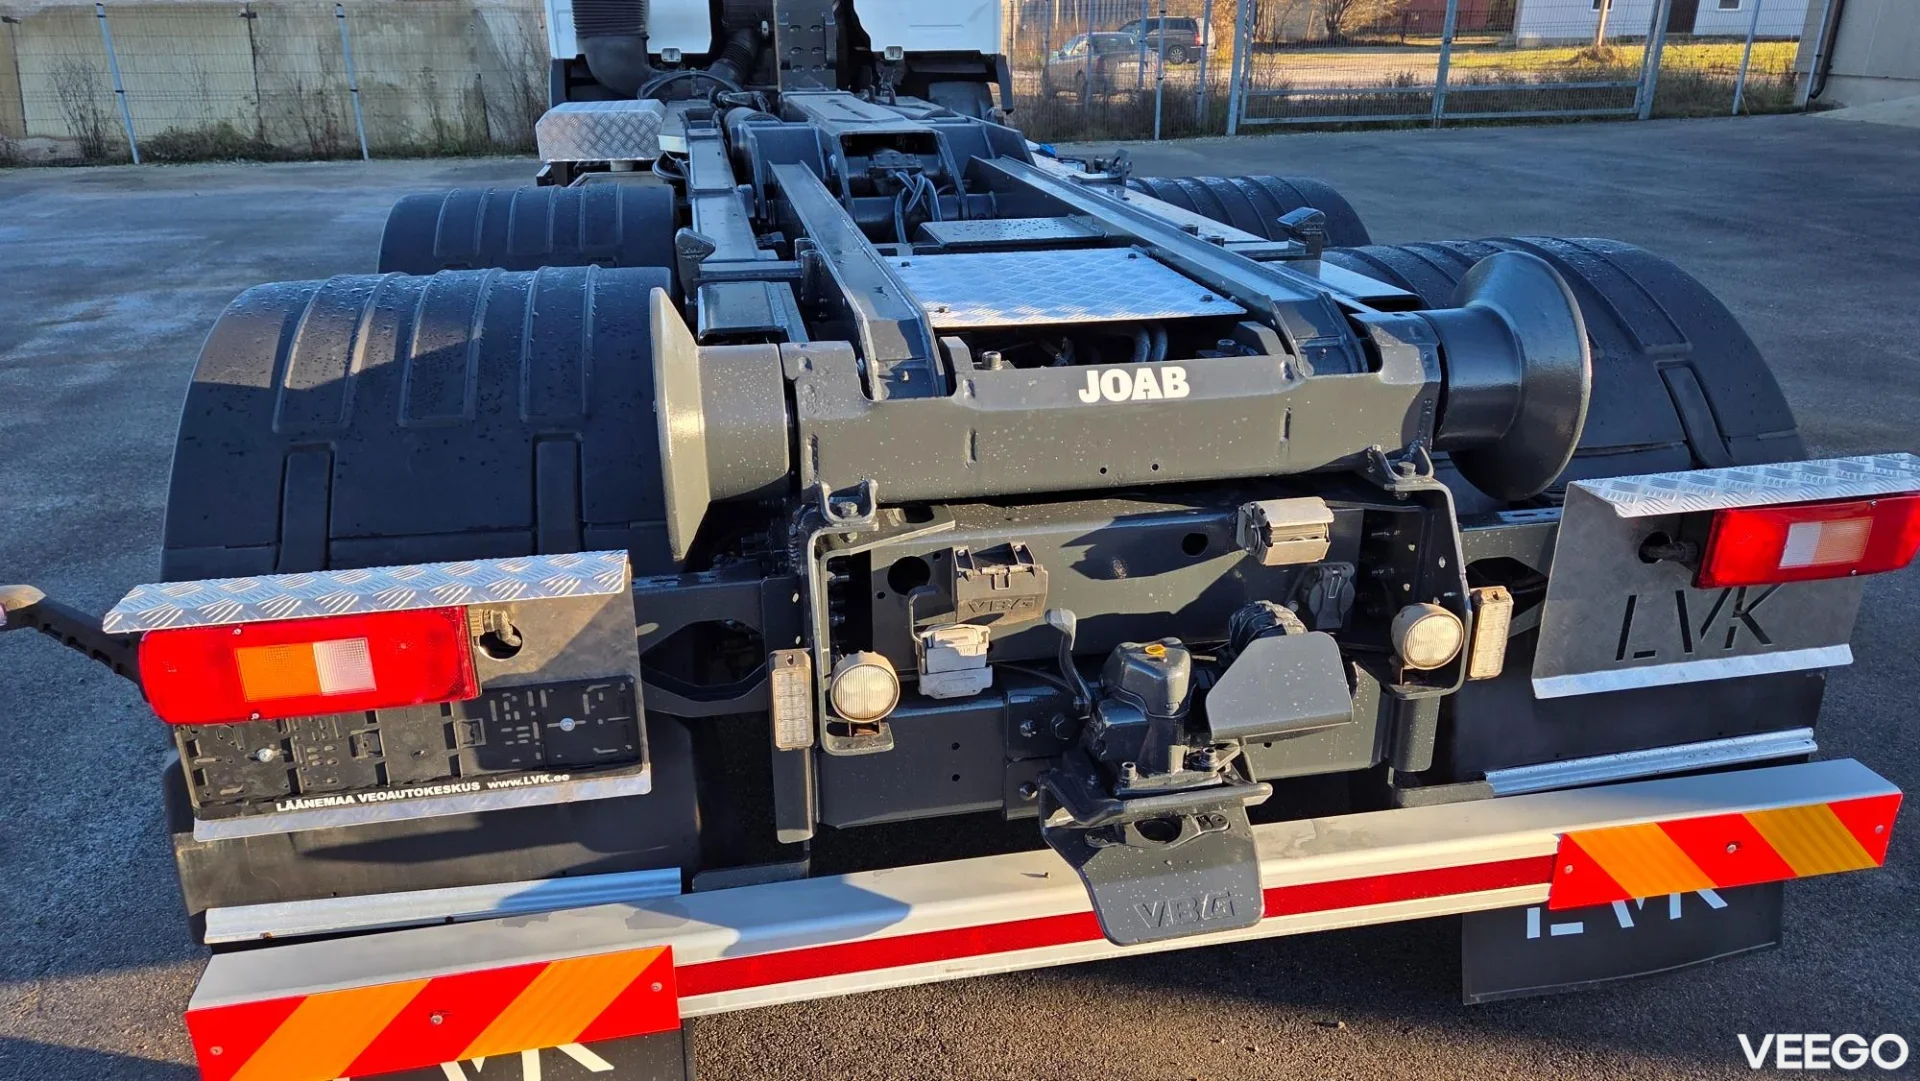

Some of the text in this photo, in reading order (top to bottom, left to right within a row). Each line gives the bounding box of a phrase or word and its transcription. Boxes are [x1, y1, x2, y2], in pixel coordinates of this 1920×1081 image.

[1078, 366, 1190, 403] JOAB
[1615, 583, 1786, 661] LVK
[276, 774, 570, 812] LÄÄNEMAA VEOAUTOKESKUS www.LVK.ee
